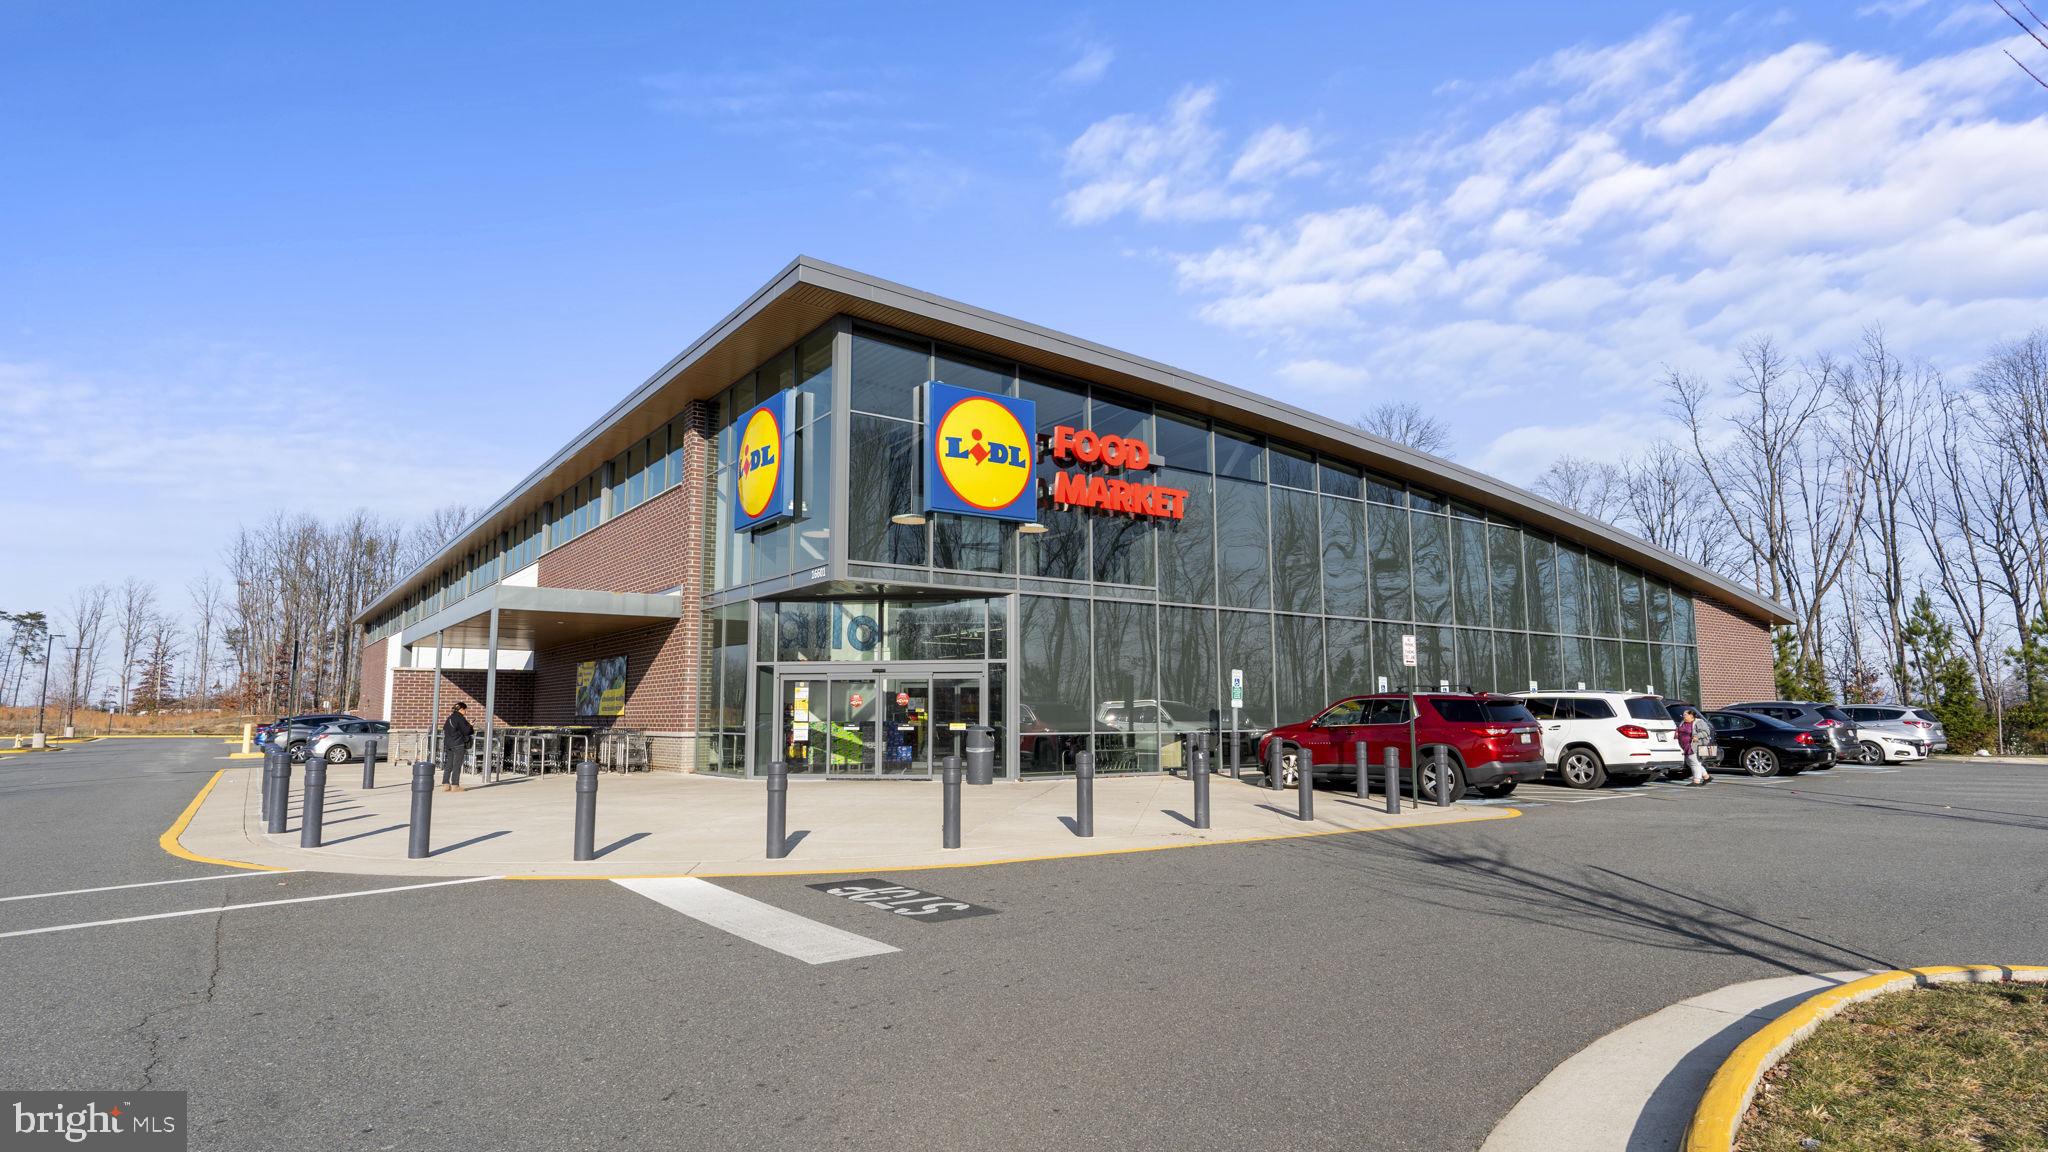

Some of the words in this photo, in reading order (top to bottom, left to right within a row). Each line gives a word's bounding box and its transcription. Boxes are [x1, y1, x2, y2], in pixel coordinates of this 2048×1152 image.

[1054, 425, 1150, 470] FOOD
[1054, 471, 1189, 520] MARKET
[826, 886, 970, 916] STOP
